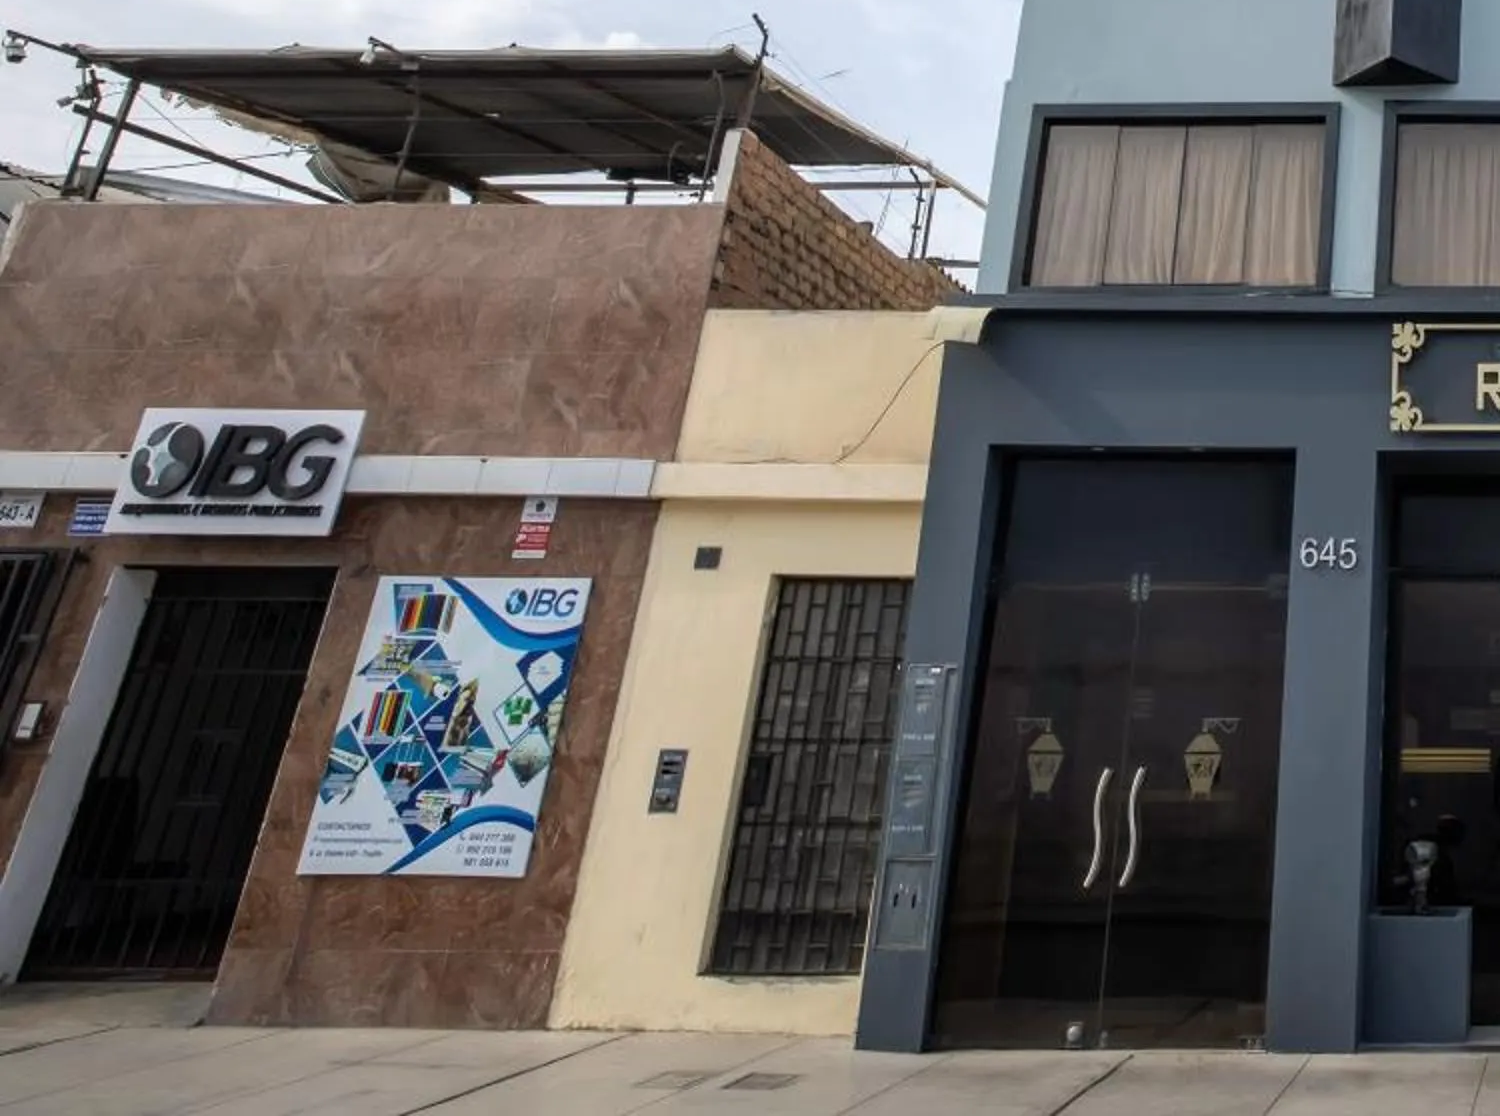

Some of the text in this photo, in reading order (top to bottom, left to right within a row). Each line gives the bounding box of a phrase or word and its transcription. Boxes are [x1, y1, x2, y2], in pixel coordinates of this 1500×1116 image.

[187, 423, 345, 501] IBG
[1300, 536, 1357, 569] 645
[524, 588, 579, 617] IBG
